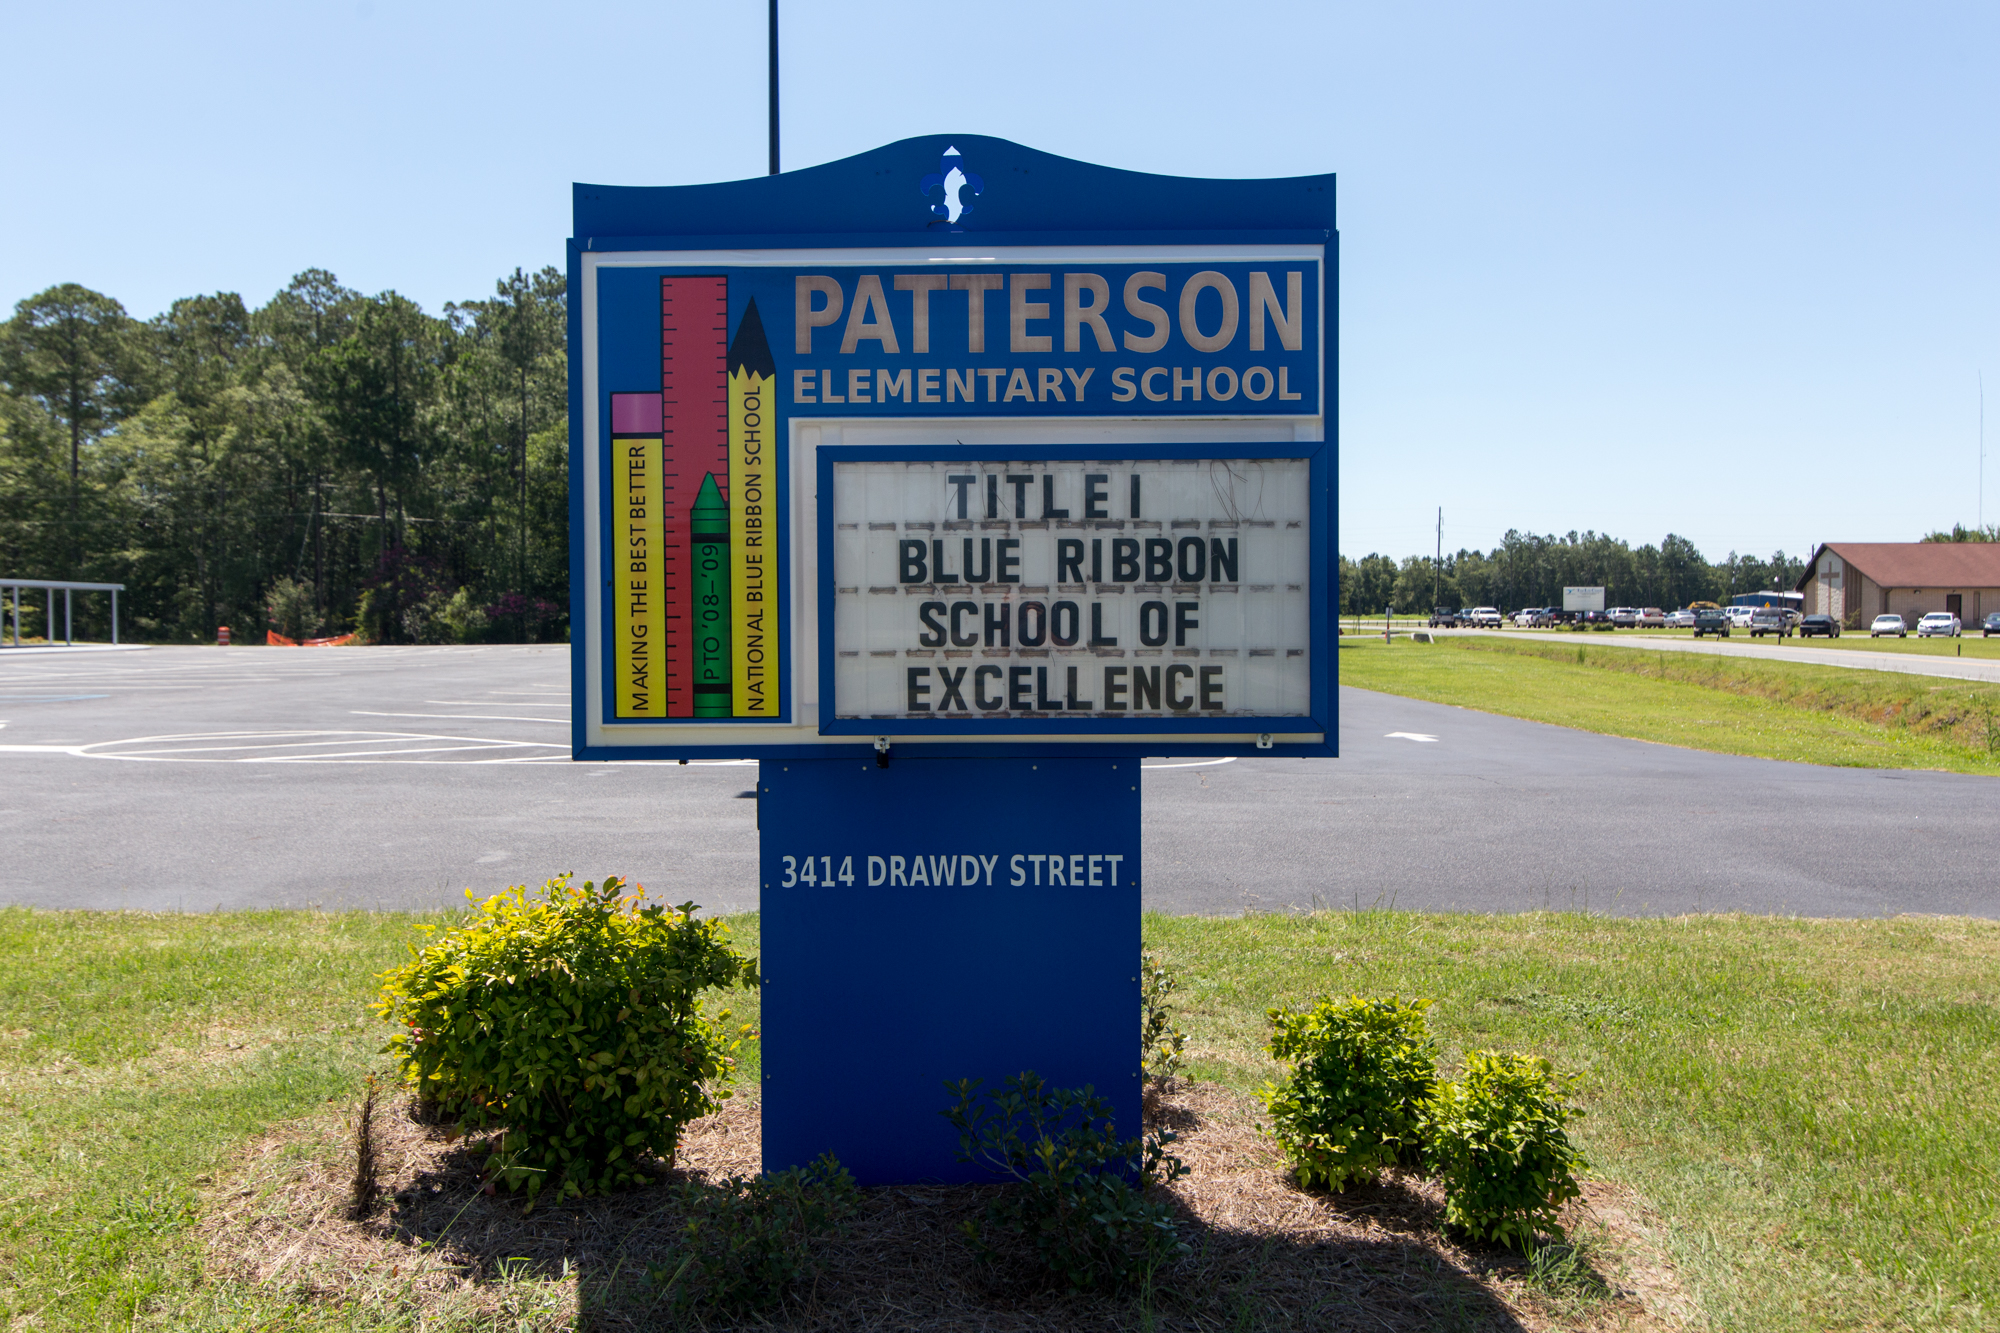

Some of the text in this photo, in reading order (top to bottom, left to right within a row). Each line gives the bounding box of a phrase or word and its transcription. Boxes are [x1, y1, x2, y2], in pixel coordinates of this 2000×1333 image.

[794, 271, 1303, 355] PATTERSON
[793, 367, 1302, 404] ELEMENTARY SCHOOL
[948, 474, 1110, 519] TITLE
[744, 386, 764, 711] NATIONAL BLUE RIBBON SCHOOL
[900, 537, 1238, 583] BLUE RIBBON
[629, 445, 649, 711] MAKING THE BEST BETTER
[919, 601, 1199, 647] SCHOOL OF
[703, 636, 720, 680] PTO
[907, 665, 1223, 711] EXCELLENCE
[781, 854, 1123, 887] 3414 DRAWDY STREET
